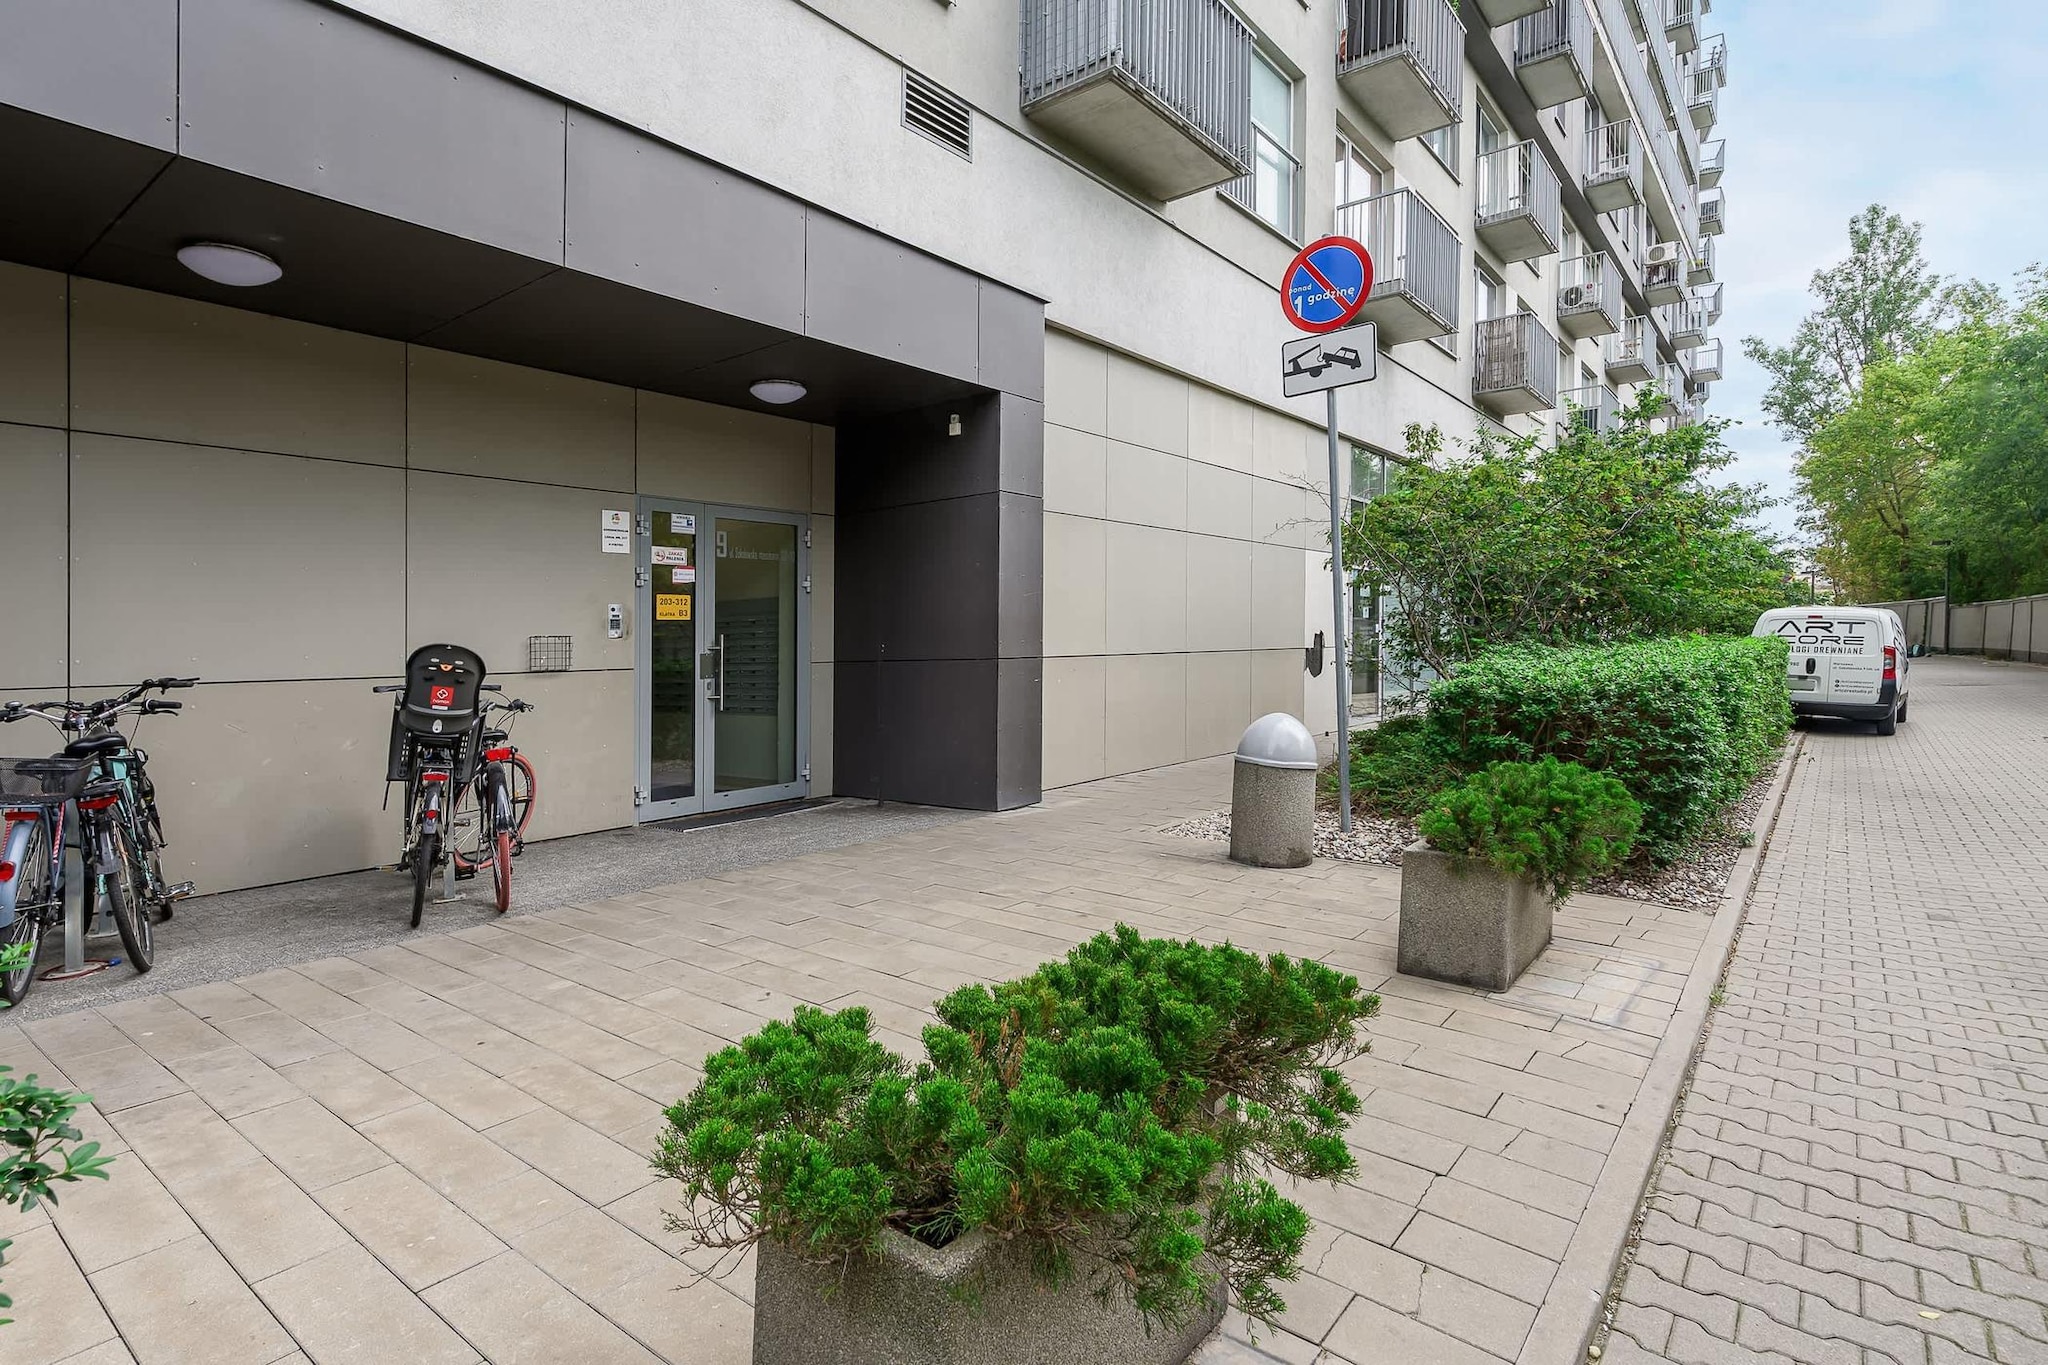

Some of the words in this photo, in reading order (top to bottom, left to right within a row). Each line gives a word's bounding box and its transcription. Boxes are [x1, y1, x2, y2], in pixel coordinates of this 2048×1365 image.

[1289, 283, 1312, 296] ponad
[1294, 295, 1303, 318] 1
[1307, 286, 1355, 306] godzinę
[716, 531, 728, 558] 9
[659, 598, 689, 606] 203-312
[678, 609, 689, 617] B3
[1777, 620, 1866, 634] ART
[1813, 646, 1864, 655] DREWNIANE
